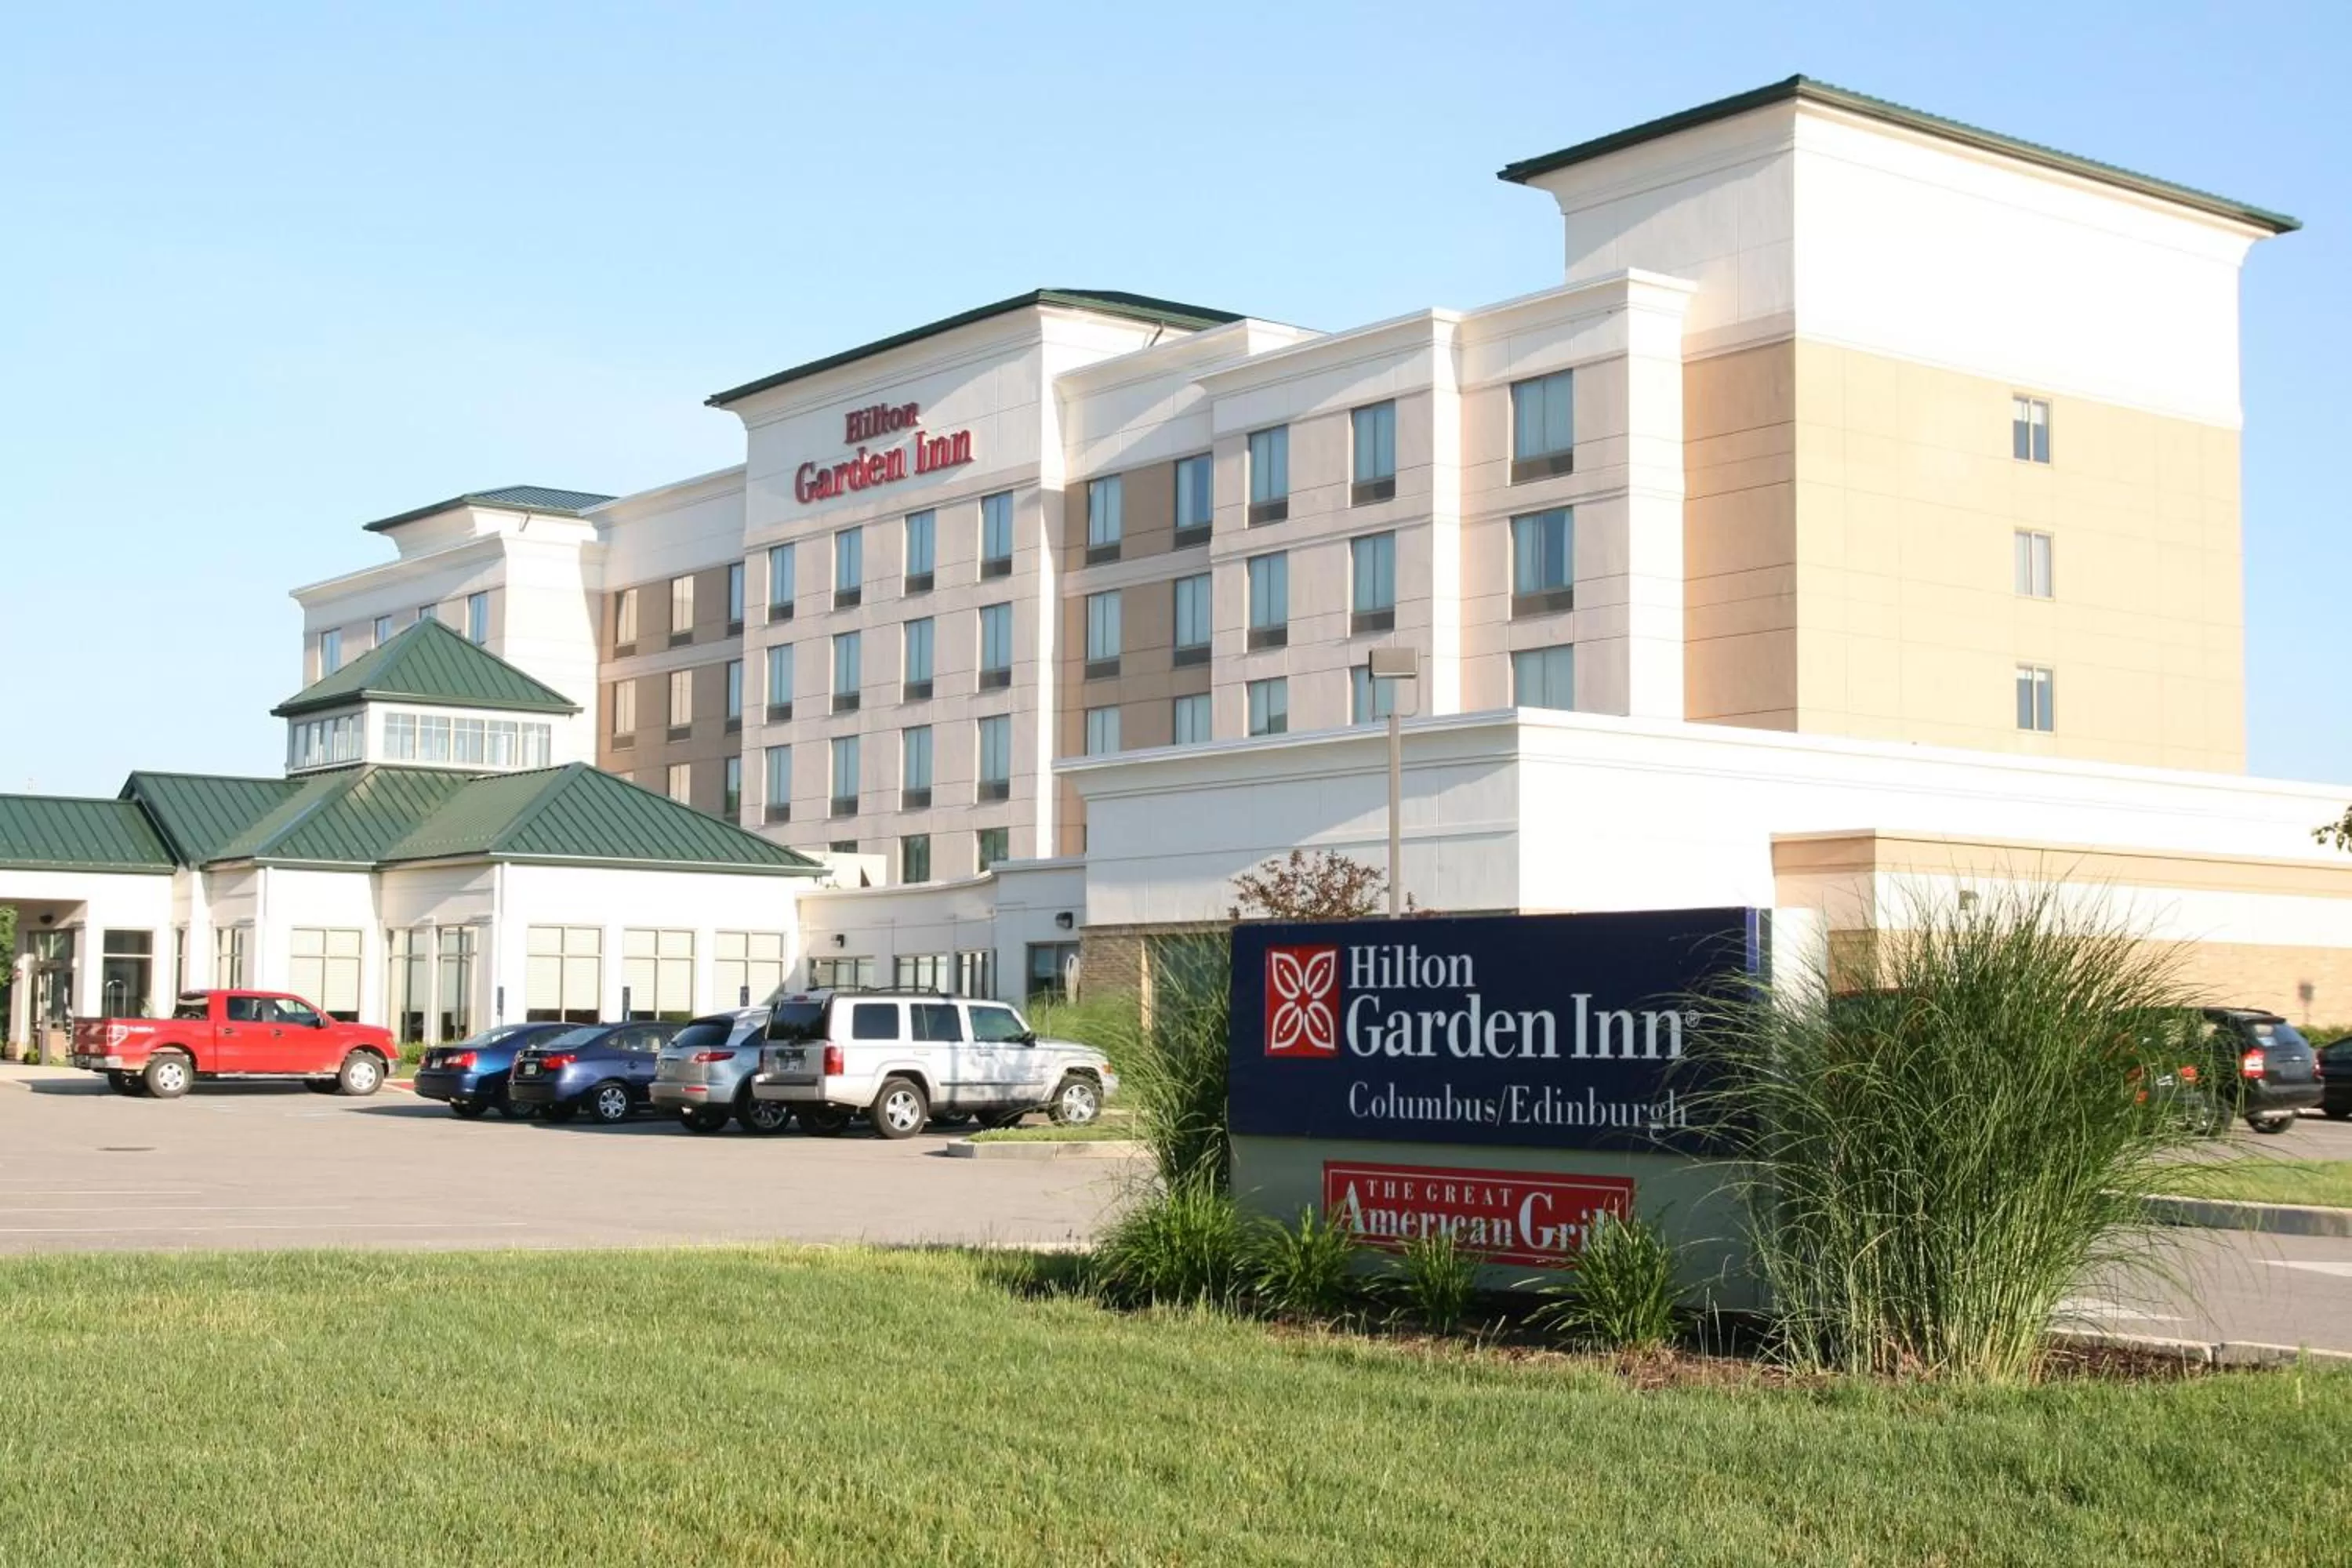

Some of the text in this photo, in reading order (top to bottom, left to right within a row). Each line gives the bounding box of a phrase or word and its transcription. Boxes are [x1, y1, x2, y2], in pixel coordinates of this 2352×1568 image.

[844, 401, 920, 445] Hilton
[794, 430, 977, 503] Garden Inn
[1348, 946, 1476, 989] Hilton
[1346, 994, 1560, 1059] Garden
[1348, 1081, 1686, 1143] Columbus/Edinburgh
[1333, 1180, 1515, 1247] American
[1367, 1179, 1513, 1207] THE GREAT
